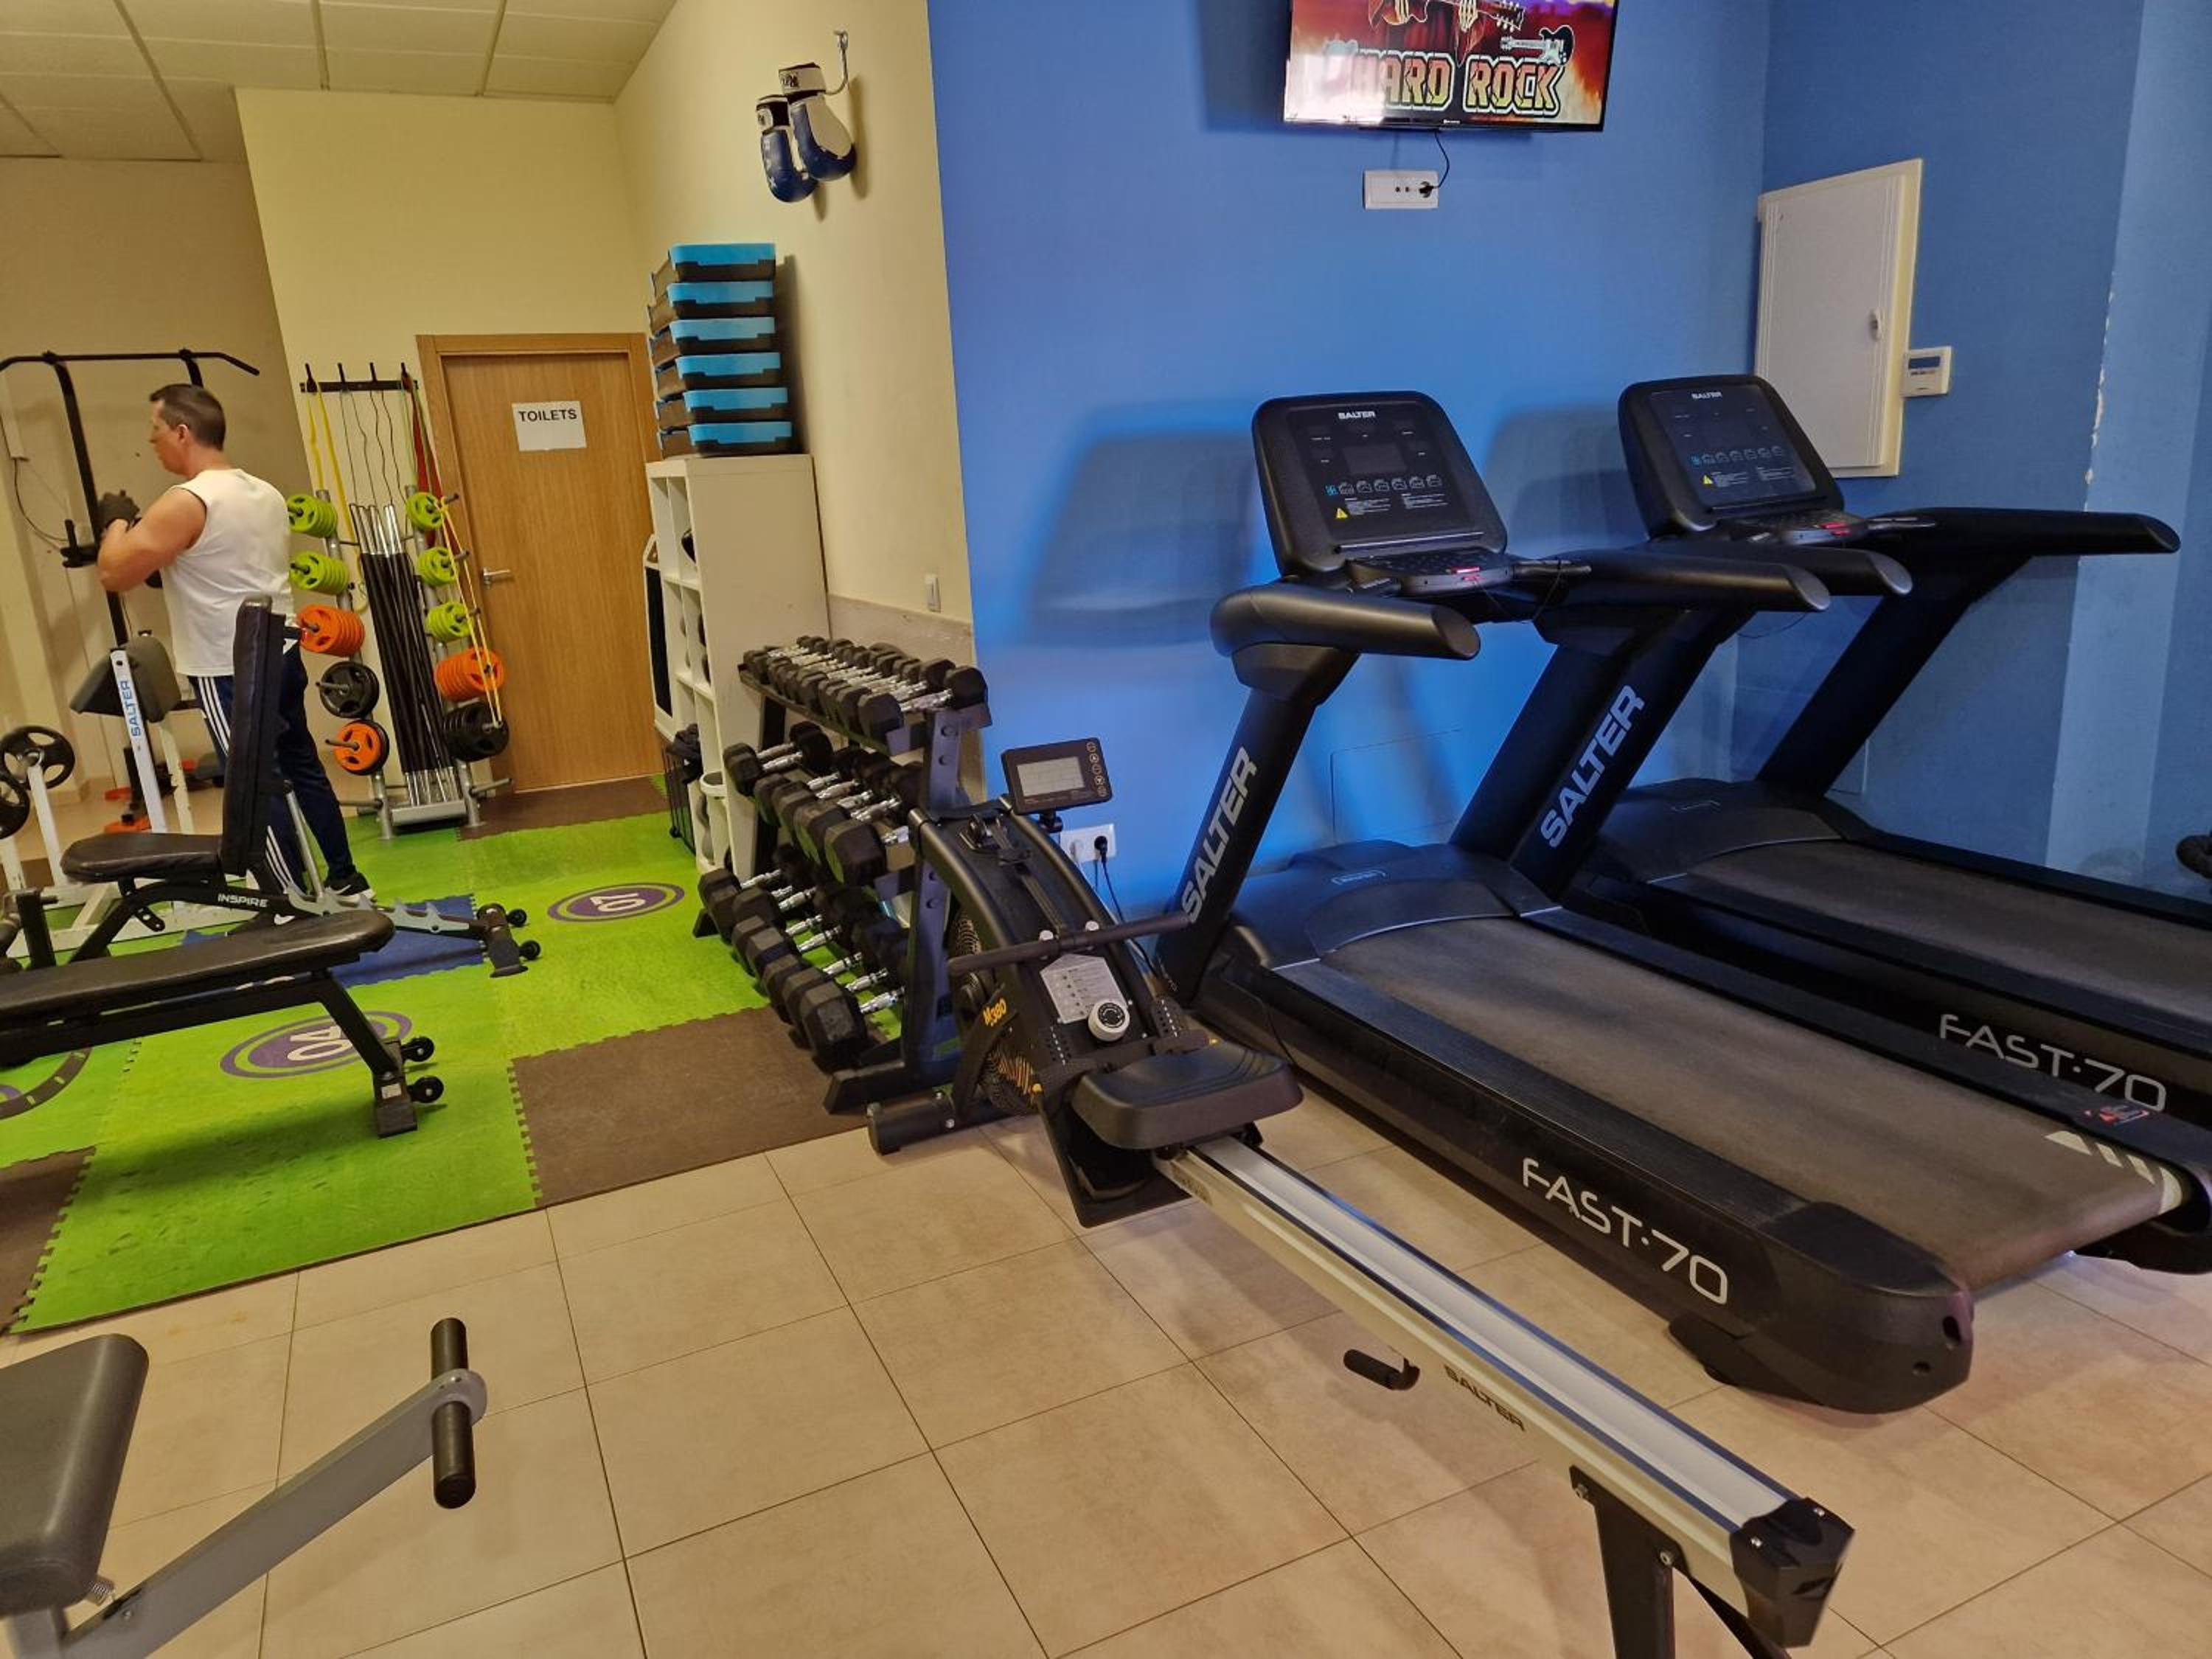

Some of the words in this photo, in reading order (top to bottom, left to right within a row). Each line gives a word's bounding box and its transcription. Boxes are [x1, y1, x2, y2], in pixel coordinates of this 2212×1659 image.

[1352, 51, 1454, 110] HARD
[1464, 57, 1563, 115] ROCK
[518, 408, 577, 422] TOILETS
[1338, 411, 1377, 420] SALTER
[119, 681, 142, 737] SALTER
[1540, 684, 1645, 849] SALTER
[1181, 746, 1258, 924] SALTER
[218, 893, 268, 908] INSPIRE
[590, 892, 646, 912] 07
[1443, 1364, 1526, 1432] SALTER
